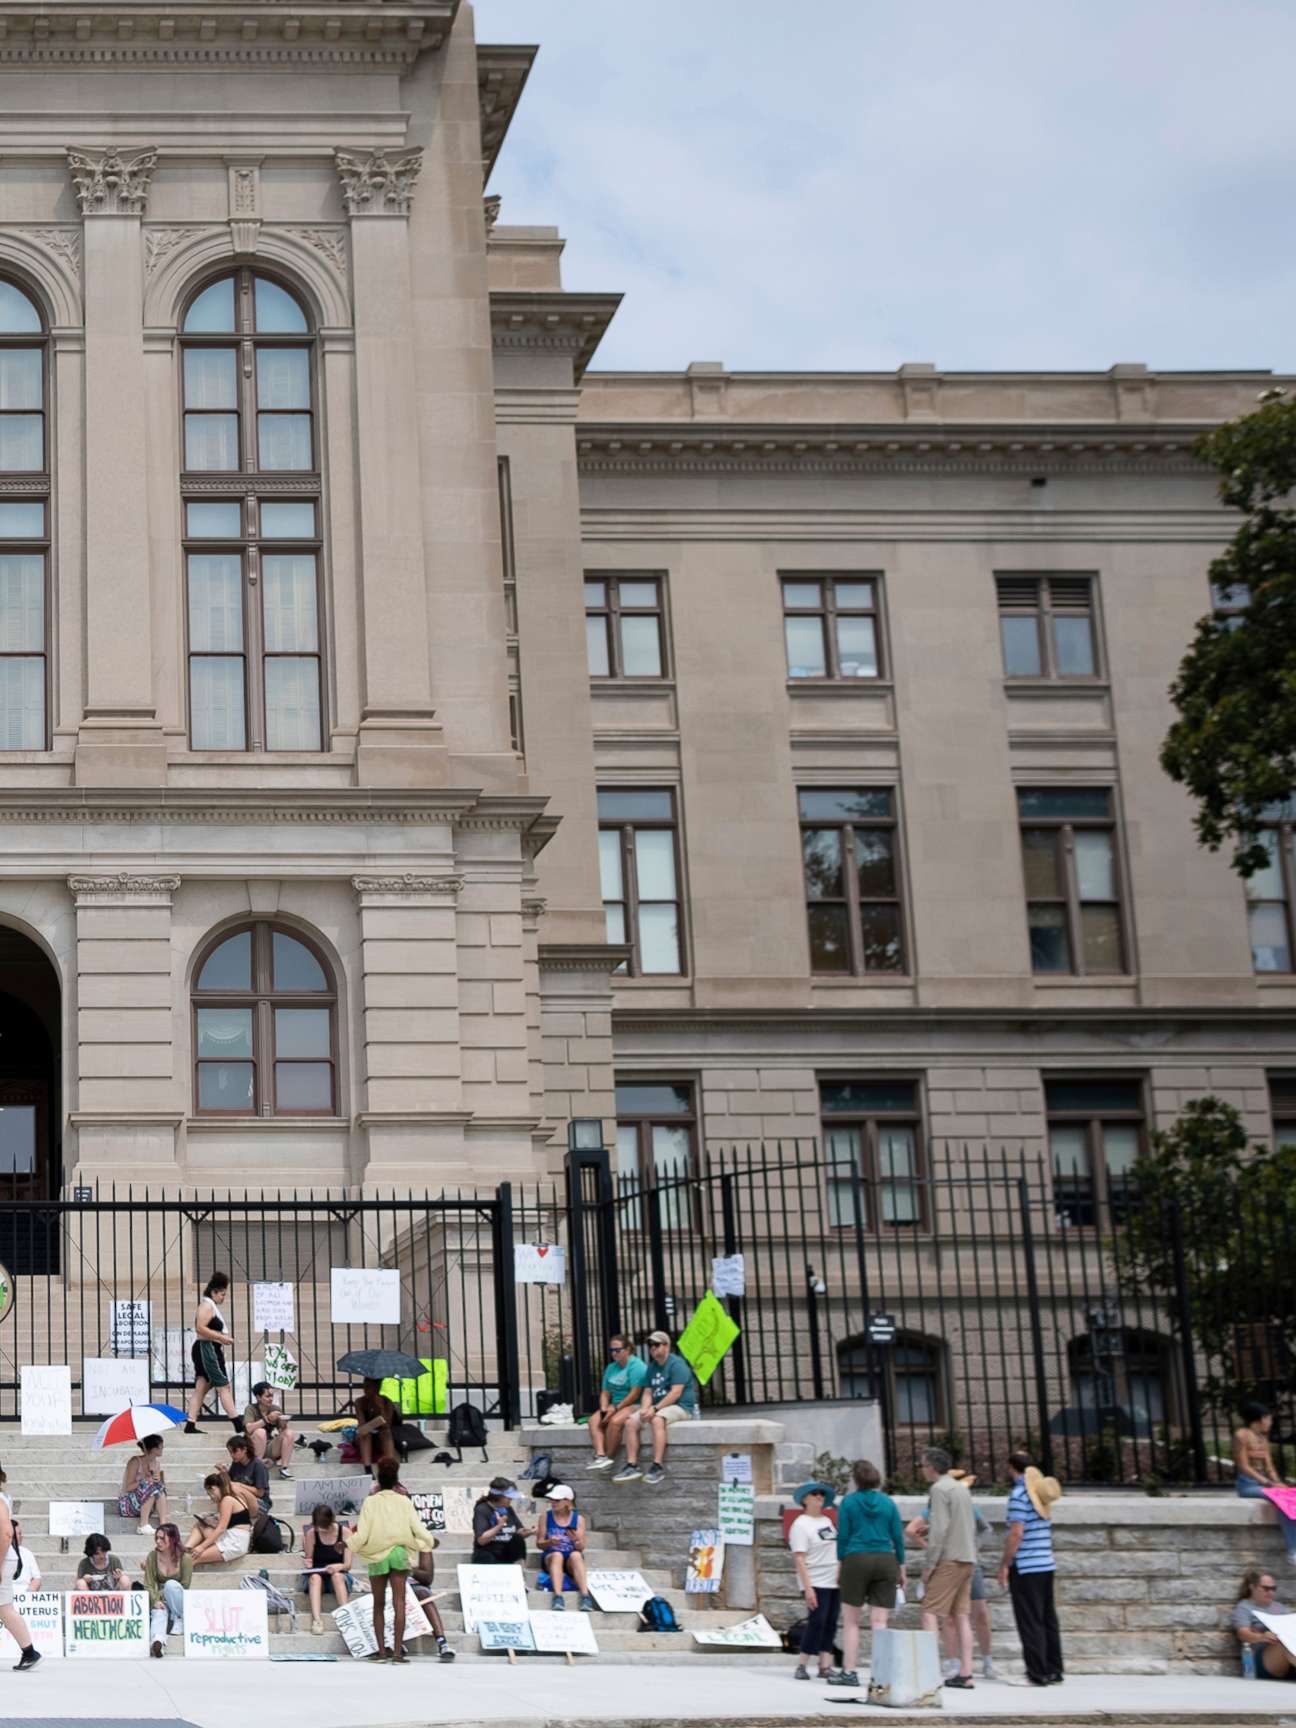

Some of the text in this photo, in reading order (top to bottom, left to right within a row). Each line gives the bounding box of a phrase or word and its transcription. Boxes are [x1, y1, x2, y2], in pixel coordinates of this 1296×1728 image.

[121, 1303, 142, 1311] SAFE
[118, 1312, 145, 1320] LEGAL
[281, 1363, 299, 1373] OFF
[312, 1479, 334, 1491] AM
[339, 1478, 363, 1489] NOT
[31, 1593, 59, 1602] HATH
[73, 1595, 124, 1615] ABORTION
[19, 1607, 59, 1616] UTERUS
[31, 1620, 57, 1629] SHUT
[334, 1607, 358, 1635] SAID
[73, 1619, 143, 1641] HEALTHCARE
[190, 1632, 261, 1647] reproductive
[347, 1637, 369, 1656] YOU
